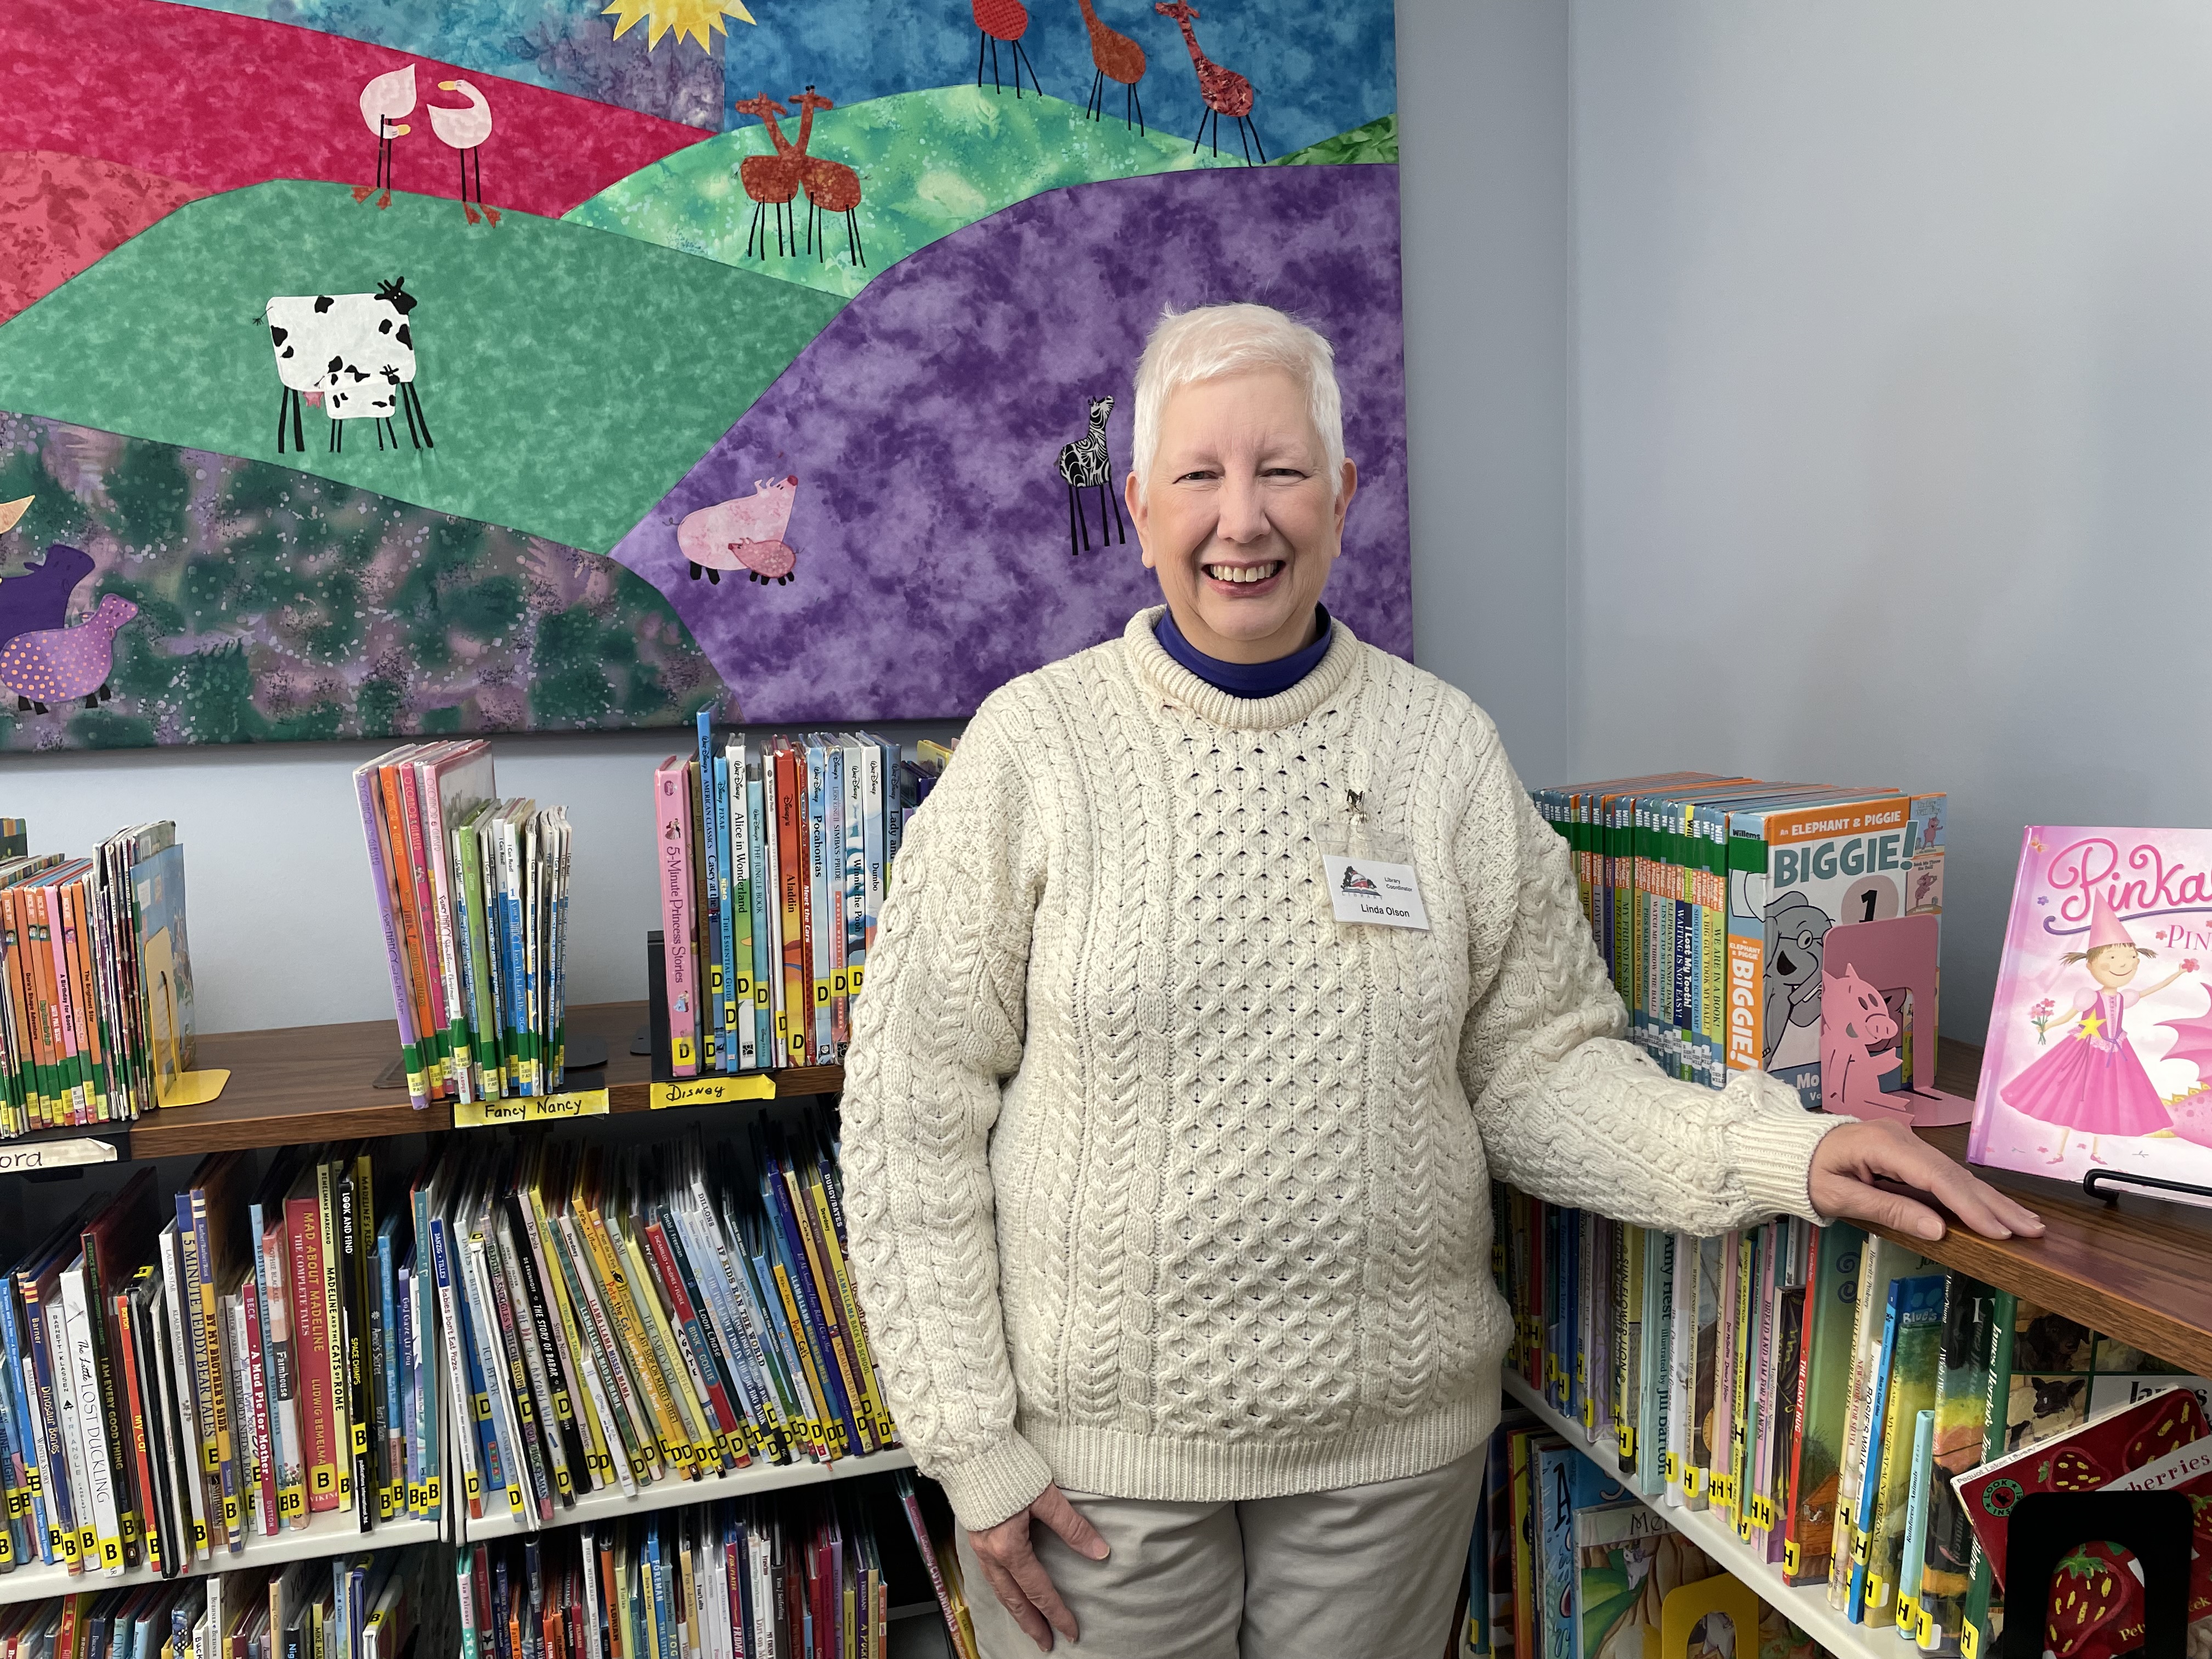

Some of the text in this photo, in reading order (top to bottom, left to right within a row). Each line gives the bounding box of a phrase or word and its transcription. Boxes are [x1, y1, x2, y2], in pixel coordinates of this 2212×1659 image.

[733, 775, 743, 800] Disney
[735, 812, 744, 838] Alice
[1733, 829, 1760, 840] Willems
[1792, 819, 1848, 836] ELEPHANT
[1853, 818, 1861, 827] &
[1865, 810, 1901, 826] PIGGIE
[736, 842, 744, 850] in
[782, 793, 797, 913] Disney's Aladdin
[1774, 821, 1919, 888] BIGGIE!
[736, 853, 747, 913] Wonderland
[2047, 838, 2212, 922] Pinka
[667, 847, 686, 983] 5-Minute Princess Stories
[1361, 904, 1410, 917] Linda Olson
[1623, 901, 1629, 916] MY
[1714, 928, 1721, 944] WE
[1677, 954, 1684, 964] IS
[1730, 943, 1760, 954] ELEPHANT
[712, 972, 723, 987] D
[1623, 964, 1629, 974] IS
[1713, 967, 1720, 980] IN
[738, 978, 749, 994] D
[817, 986, 828, 1001] D
[836, 975, 846, 991] D
[1713, 984, 1720, 994] A
[1730, 959, 1759, 1068] BIGGIE!
[485, 1097, 582, 1120] Fancy Nancy
[824, 1173, 843, 1227] DUNGY/BATES
[342, 1192, 353, 1254] LOOK AND FIND
[802, 1220, 811, 1242] Cars
[567, 1233, 578, 1257] Dewdney
[185, 1251, 200, 1307] MINUTE
[303, 1212, 324, 1352] MAD ABOUT MADELINE
[698, 1193, 765, 1367] DILLONS IF KIDS RAN THE WORLD
[247, 1297, 255, 1320] BECK
[442, 1289, 450, 1314] Babies
[613, 1233, 678, 1385] DEMI THE EMPTY POT
[445, 1316, 454, 1335] Don't
[1903, 1310, 1937, 1324] Blue's
[191, 1310, 207, 1358] TEDDY
[449, 1336, 457, 1351] Eat
[791, 1319, 808, 1359] Pete Cat's
[589, 1299, 630, 1398] LLAMA LLAMA MISSES MAMA
[678, 1329, 698, 1376] AGATE
[688, 1326, 715, 1381] BINK GOLLIE
[206, 1313, 227, 1432] BY MY BROTHER'S SIDE
[351, 1338, 361, 1385] SPACE CHIMPS
[197, 1361, 212, 1395] BEAR
[1984, 1322, 2002, 1427] James Herriot's
[1796, 1378, 1806, 1405] GIANT
[78, 1340, 110, 1503] The Little LOST DUCKLING
[201, 1397, 216, 1438] TALES
[251, 1351, 269, 1475] A Mud Pie for Mother
[312, 1378, 326, 1465] LUDWIG BEMELMA
[1795, 1407, 1803, 1434] HUG
[356, 1430, 366, 1446] B
[1859, 1387, 1873, 1468] ROSIE'S WALK
[587, 1454, 597, 1469] D
[671, 1447, 682, 1462] D
[708, 1446, 720, 1461] D
[633, 1459, 645, 1473] D
[1956, 1469, 1985, 1485] Pequot
[1984, 1460, 2007, 1476] Lakes
[2124, 1454, 2210, 1491] berries
[31, 1475, 41, 1491] B
[318, 1472, 330, 1488] B
[429, 1483, 438, 1499] B
[1684, 1470, 1692, 1489] H
[8, 1496, 20, 1513] B
[289, 1493, 300, 1508] B
[123, 1520, 134, 1536] B
[65, 1540, 76, 1556] B
[82, 1532, 94, 1548] B
[105, 1544, 117, 1560] B
[652, 1559, 664, 1602] FOREMAN
[610, 1603, 619, 1642] FLORIAN
[314, 1627, 323, 1643] MIKE
[669, 1634, 678, 1656] FOG
